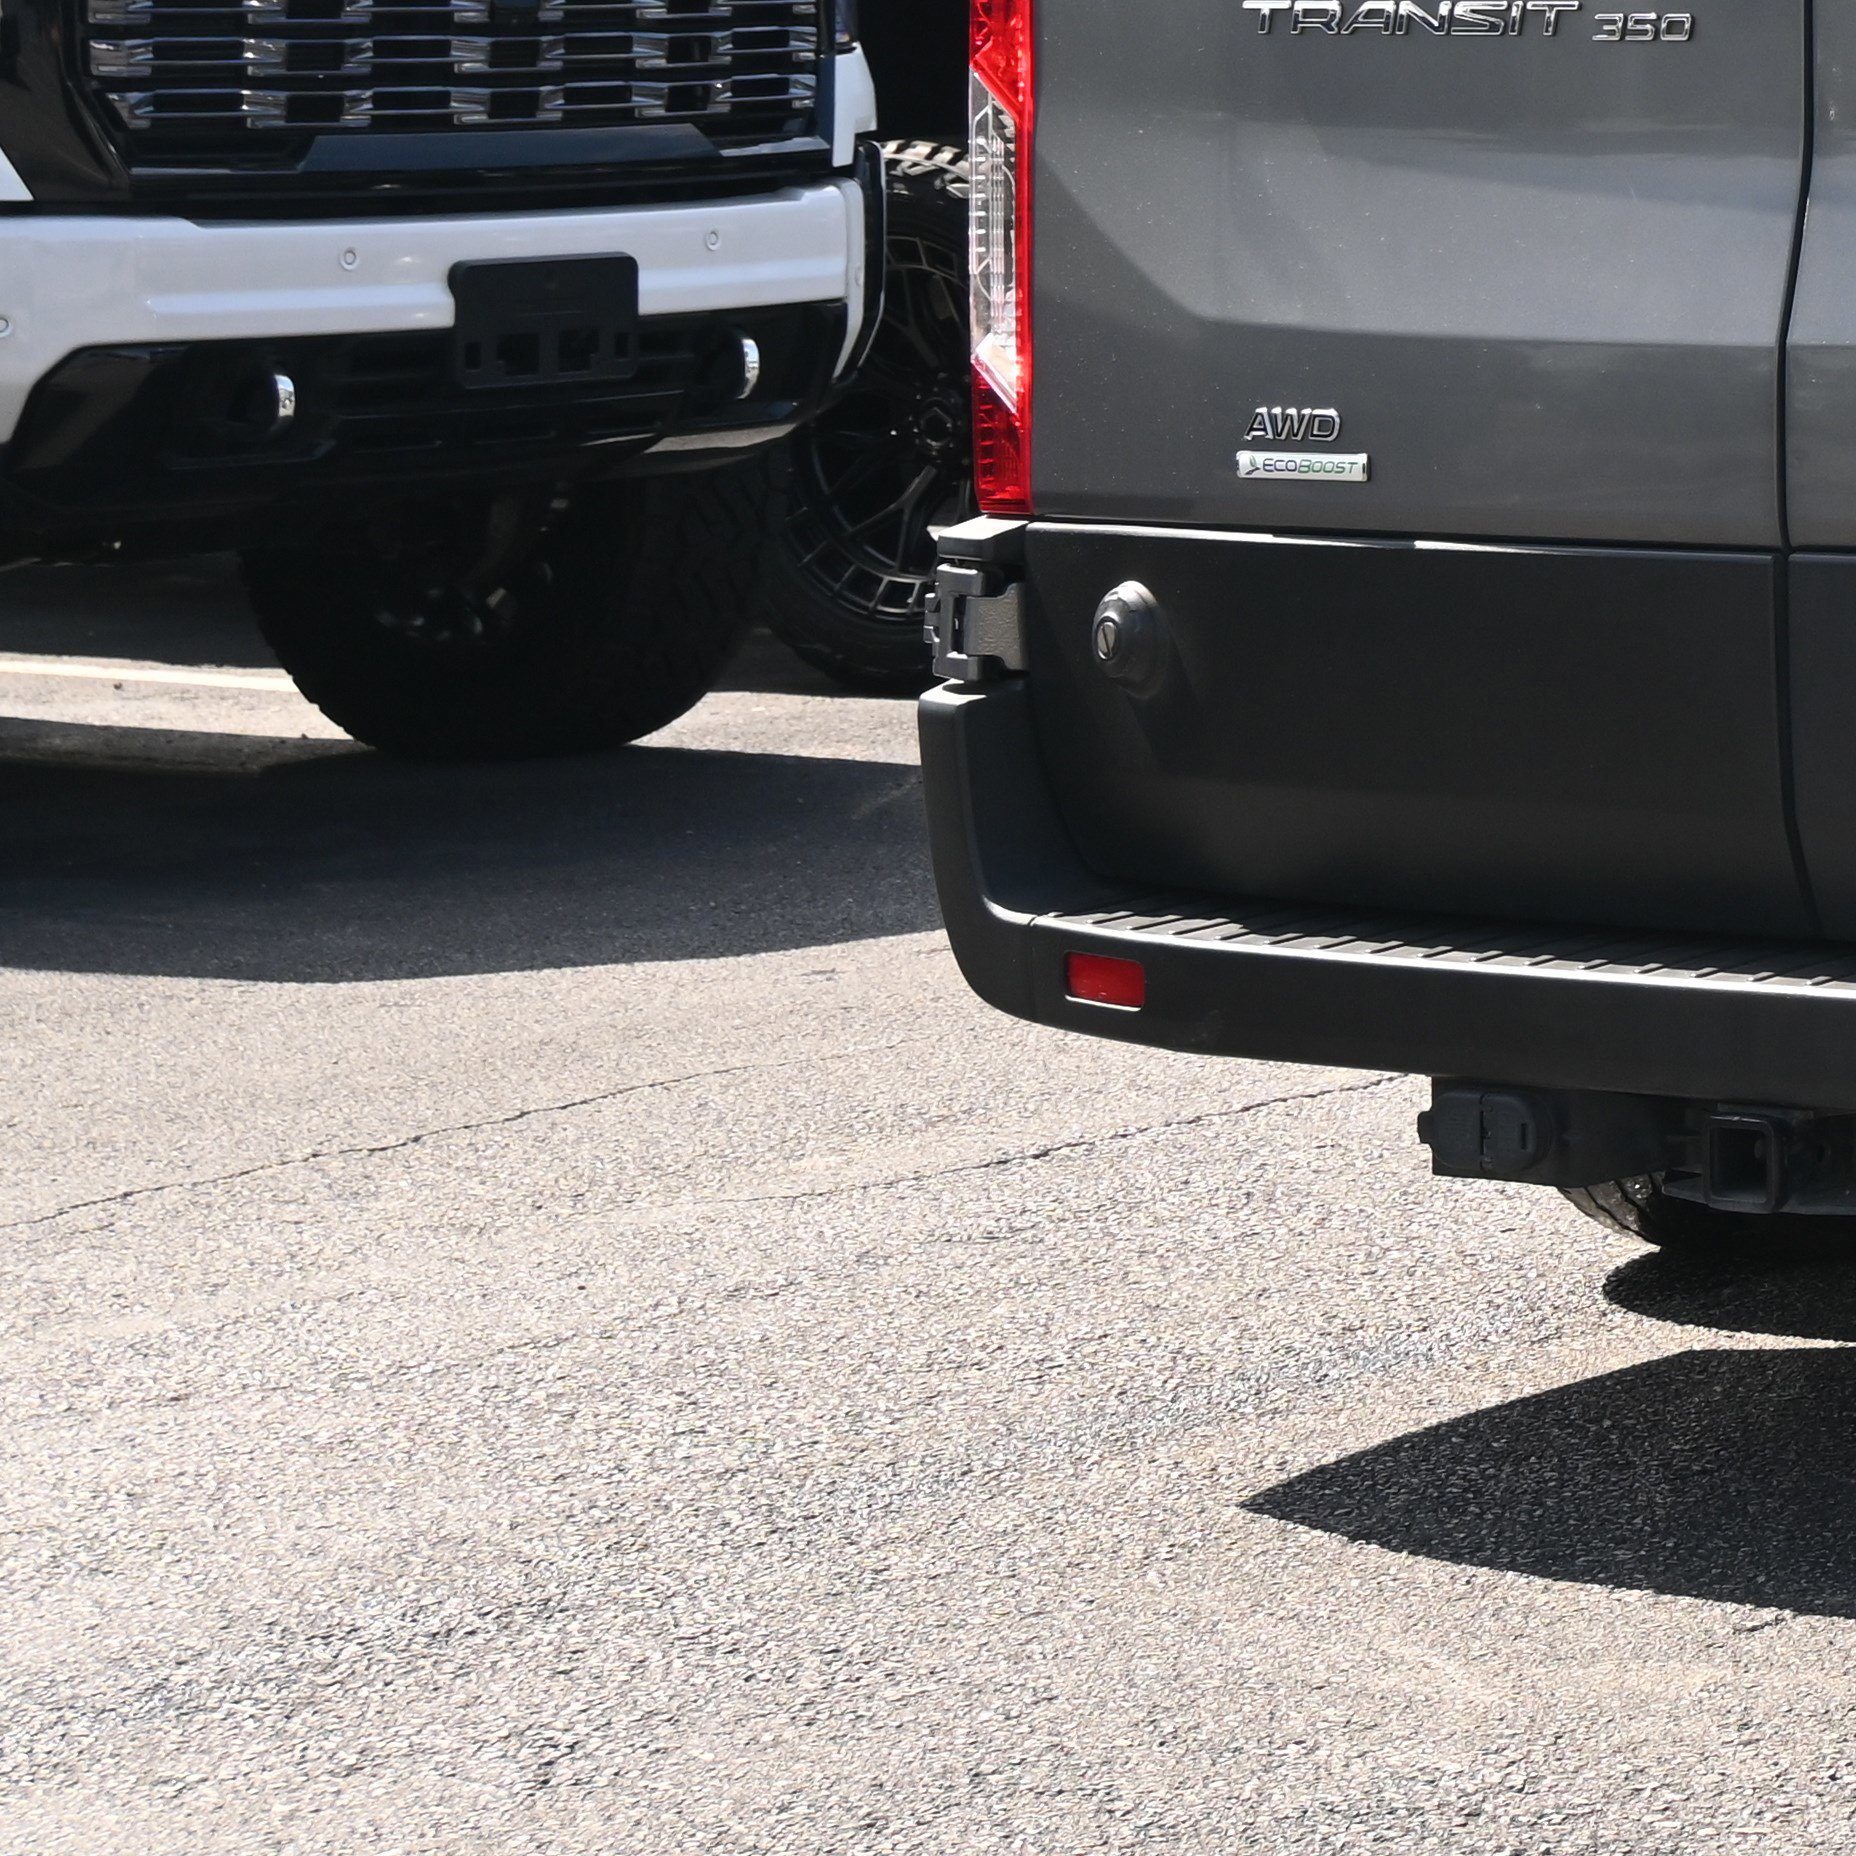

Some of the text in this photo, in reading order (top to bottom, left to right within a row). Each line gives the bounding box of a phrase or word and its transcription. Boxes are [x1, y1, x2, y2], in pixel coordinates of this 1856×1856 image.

[1242, 0, 1696, 42] TRANSIT 350
[1242, 406, 1341, 442] AWD
[1262, 457, 1359, 475] ECOBOOST
